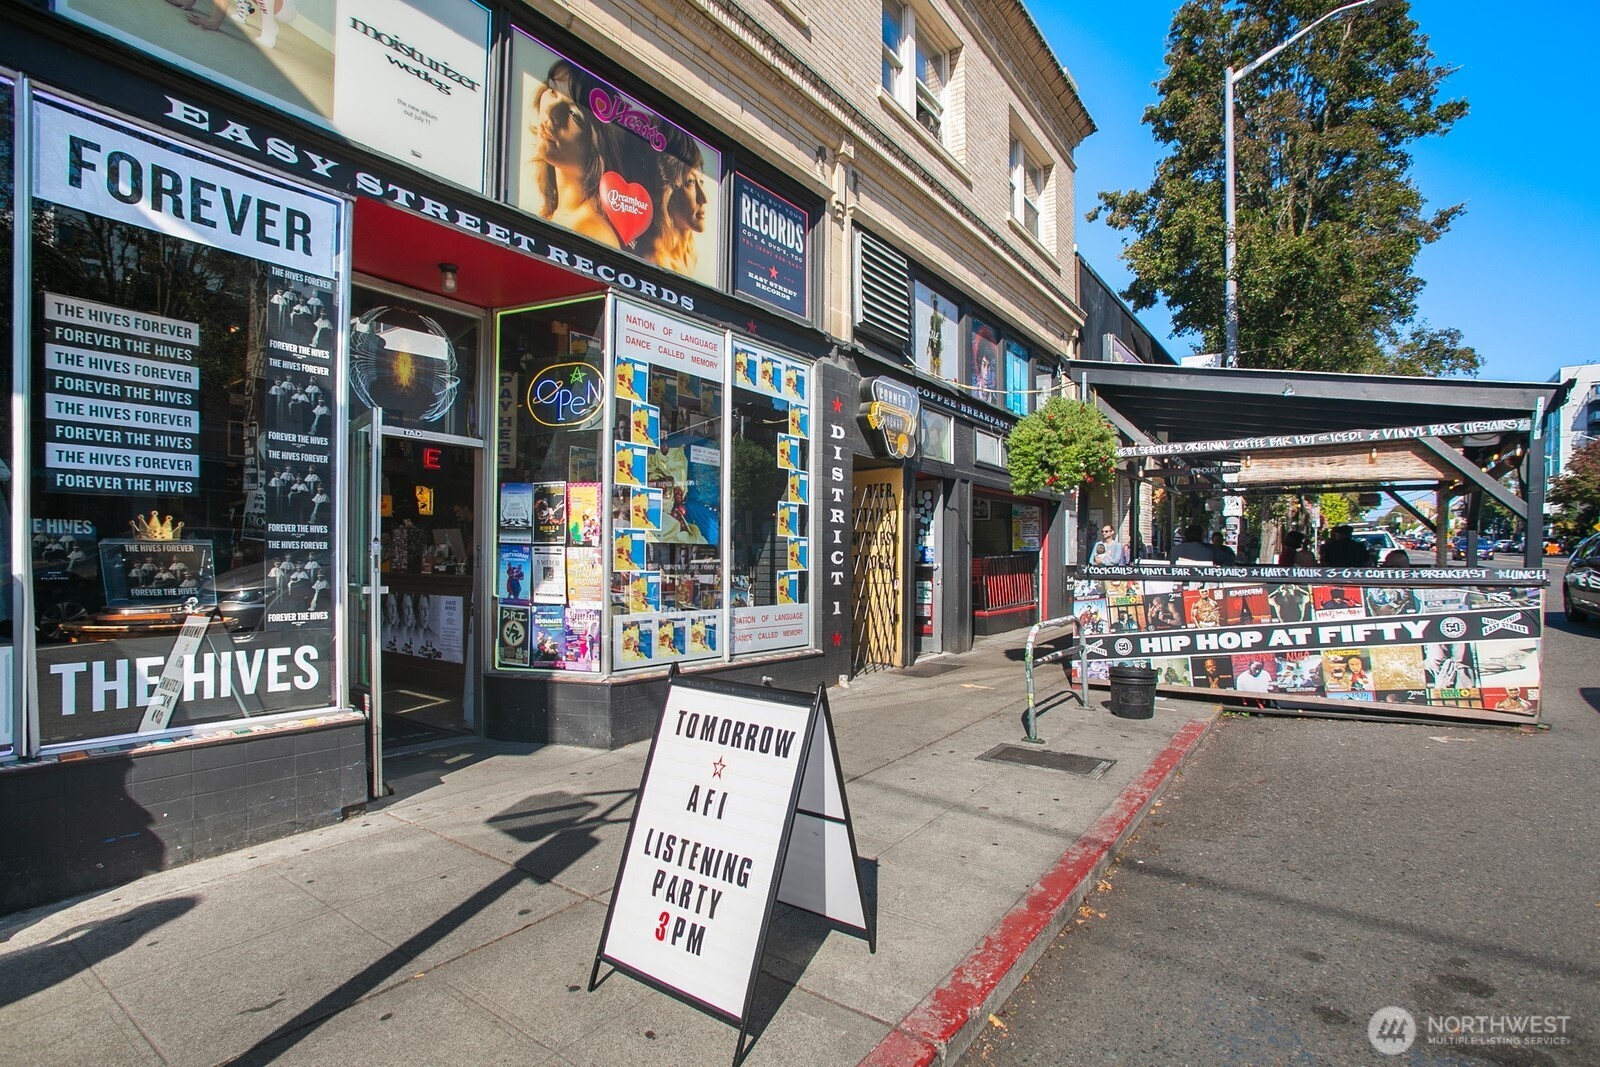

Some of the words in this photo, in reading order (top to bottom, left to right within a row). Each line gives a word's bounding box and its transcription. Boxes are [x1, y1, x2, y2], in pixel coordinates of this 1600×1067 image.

[350, 16, 481, 93] moisturizer
[403, 110, 413, 118] out
[408, 104, 420, 113] new
[421, 108, 438, 121] album
[589, 87, 667, 152] Heart
[68, 134, 313, 257] FOREVER
[164, 95, 340, 178] EASY
[356, 172, 536, 251] STREET
[547, 247, 695, 312] RECORDS
[607, 189, 648, 211] Dreamboat
[611, 200, 643, 215] Annie
[743, 184, 765, 200] WE'LL
[769, 199, 782, 210] BUY
[785, 207, 803, 221] YOUR
[741, 192, 804, 254] RECORDS
[742, 229, 758, 241] CD'S
[790, 253, 803, 263] TOO
[271, 266, 283, 277] THE
[285, 269, 303, 283] HIVES
[304, 275, 332, 290] FOREVER
[748, 271, 768, 285] EASY
[769, 280, 797, 298] STREET
[755, 281, 791, 301] RECORDS
[55, 302, 84, 319] THE
[88, 308, 131, 328] HIVES
[134, 317, 192, 339] FOREVER
[626, 314, 655, 332] NATION
[662, 326, 673, 337] OF
[680, 332, 718, 352] LANGUAGE
[55, 326, 121, 350] FOREVER
[124, 338, 151, 355] THE
[154, 344, 192, 361] HIVES
[269, 340, 297, 353] FOREVER
[298, 344, 310, 355] THE
[311, 346, 329, 360] HIVES
[625, 335, 651, 351] DANCE
[658, 345, 685, 360] CALLED
[691, 355, 718, 370] MEMORY
[55, 351, 84, 368] THE
[88, 356, 131, 375] HIVES
[134, 363, 192, 383] FOREVER
[269, 357, 281, 368] THE
[282, 359, 301, 371] HIVES
[301, 363, 329, 376] FOREVER
[55, 375, 121, 397] FOREVER
[124, 386, 151, 401] THE
[154, 390, 192, 406] HIVES
[499, 376, 513, 411] PAY
[879, 386, 907, 408] CORNER
[55, 400, 84, 416] THE
[88, 405, 131, 421] HIVES
[134, 410, 192, 428] FOREVER
[916, 386, 956, 409] COFFEE
[960, 404, 1009, 430] BREAKFAST
[55, 424, 121, 444] FOREVER
[124, 432, 151, 447] THE
[155, 436, 192, 450] HIVES
[268, 431, 297, 442] FOREVER
[297, 435, 309, 444] THE
[310, 437, 328, 446] HIVES
[1185, 440, 1231, 452] ORIGINAL
[1233, 436, 1266, 449] COFFEE
[1269, 436, 1292, 447] BAR
[1295, 434, 1317, 445] HOT
[1331, 431, 1363, 443] ICED!
[1382, 426, 1428, 441] VINYL
[1429, 423, 1461, 436] BAR
[1463, 419, 1517, 433] UPSTAIRS
[55, 450, 84, 464] THE
[89, 452, 131, 467] HIVES
[135, 456, 192, 472] FOREVER
[268, 450, 280, 459] THE
[282, 451, 300, 461] HIVES
[301, 454, 328, 463] FOREVER
[56, 473, 121, 489] FOREVER
[124, 478, 151, 492] THE
[155, 481, 193, 494] HIVES
[830, 424, 845, 586] DISTRICT
[47, 519, 93, 535] HIVES
[268, 523, 296, 533] FOREVER
[297, 524, 309, 533] THE
[310, 525, 328, 534] HIVES
[124, 545, 139, 553] THE
[140, 545, 161, 553] HIVES
[162, 544, 194, 553] FOREVER
[268, 540, 280, 549] THE
[281, 540, 300, 549] HIVES
[301, 541, 328, 550] FOREVER
[1089, 565, 1133, 575] COCKTAILS
[1140, 567, 1168, 576] VINYL
[1171, 567, 1191, 576] BAR
[1203, 568, 1248, 577] UPSTAIRS
[1260, 567, 1289, 577] HAPPY
[1292, 568, 1321, 578] HOUR
[1327, 568, 1351, 578] 3-6
[1365, 569, 1411, 579] COFFEE
[1420, 569, 1487, 579] BREAKFAST
[1505, 568, 1547, 580] LUNCH
[131, 588, 162, 597] FOREVER
[163, 588, 176, 596] THE
[178, 587, 199, 596] HIVES
[268, 613, 296, 622] FOREVER
[297, 612, 309, 621] THE
[310, 611, 328, 620] HIVES
[502, 609, 528, 621] D.R.I.
[761, 614, 769, 622] OF
[774, 612, 803, 622] LANGUAGE
[1446, 622, 1460, 632] 50
[758, 631, 778, 640] CALLED
[783, 629, 803, 638] MEMORY
[1139, 634, 1191, 653] HIP
[1195, 630, 1263, 650] HOP
[1268, 627, 1312, 647] AT
[1318, 619, 1431, 644] FIFTY
[50, 656, 165, 716] THE
[183, 645, 319, 702] HIVES
[675, 710, 796, 759] TOMORROW
[686, 785, 728, 820] AFI
[644, 828, 753, 889] LISTENING
[651, 869, 723, 920] PARTY
[655, 911, 706, 956] 3PM
